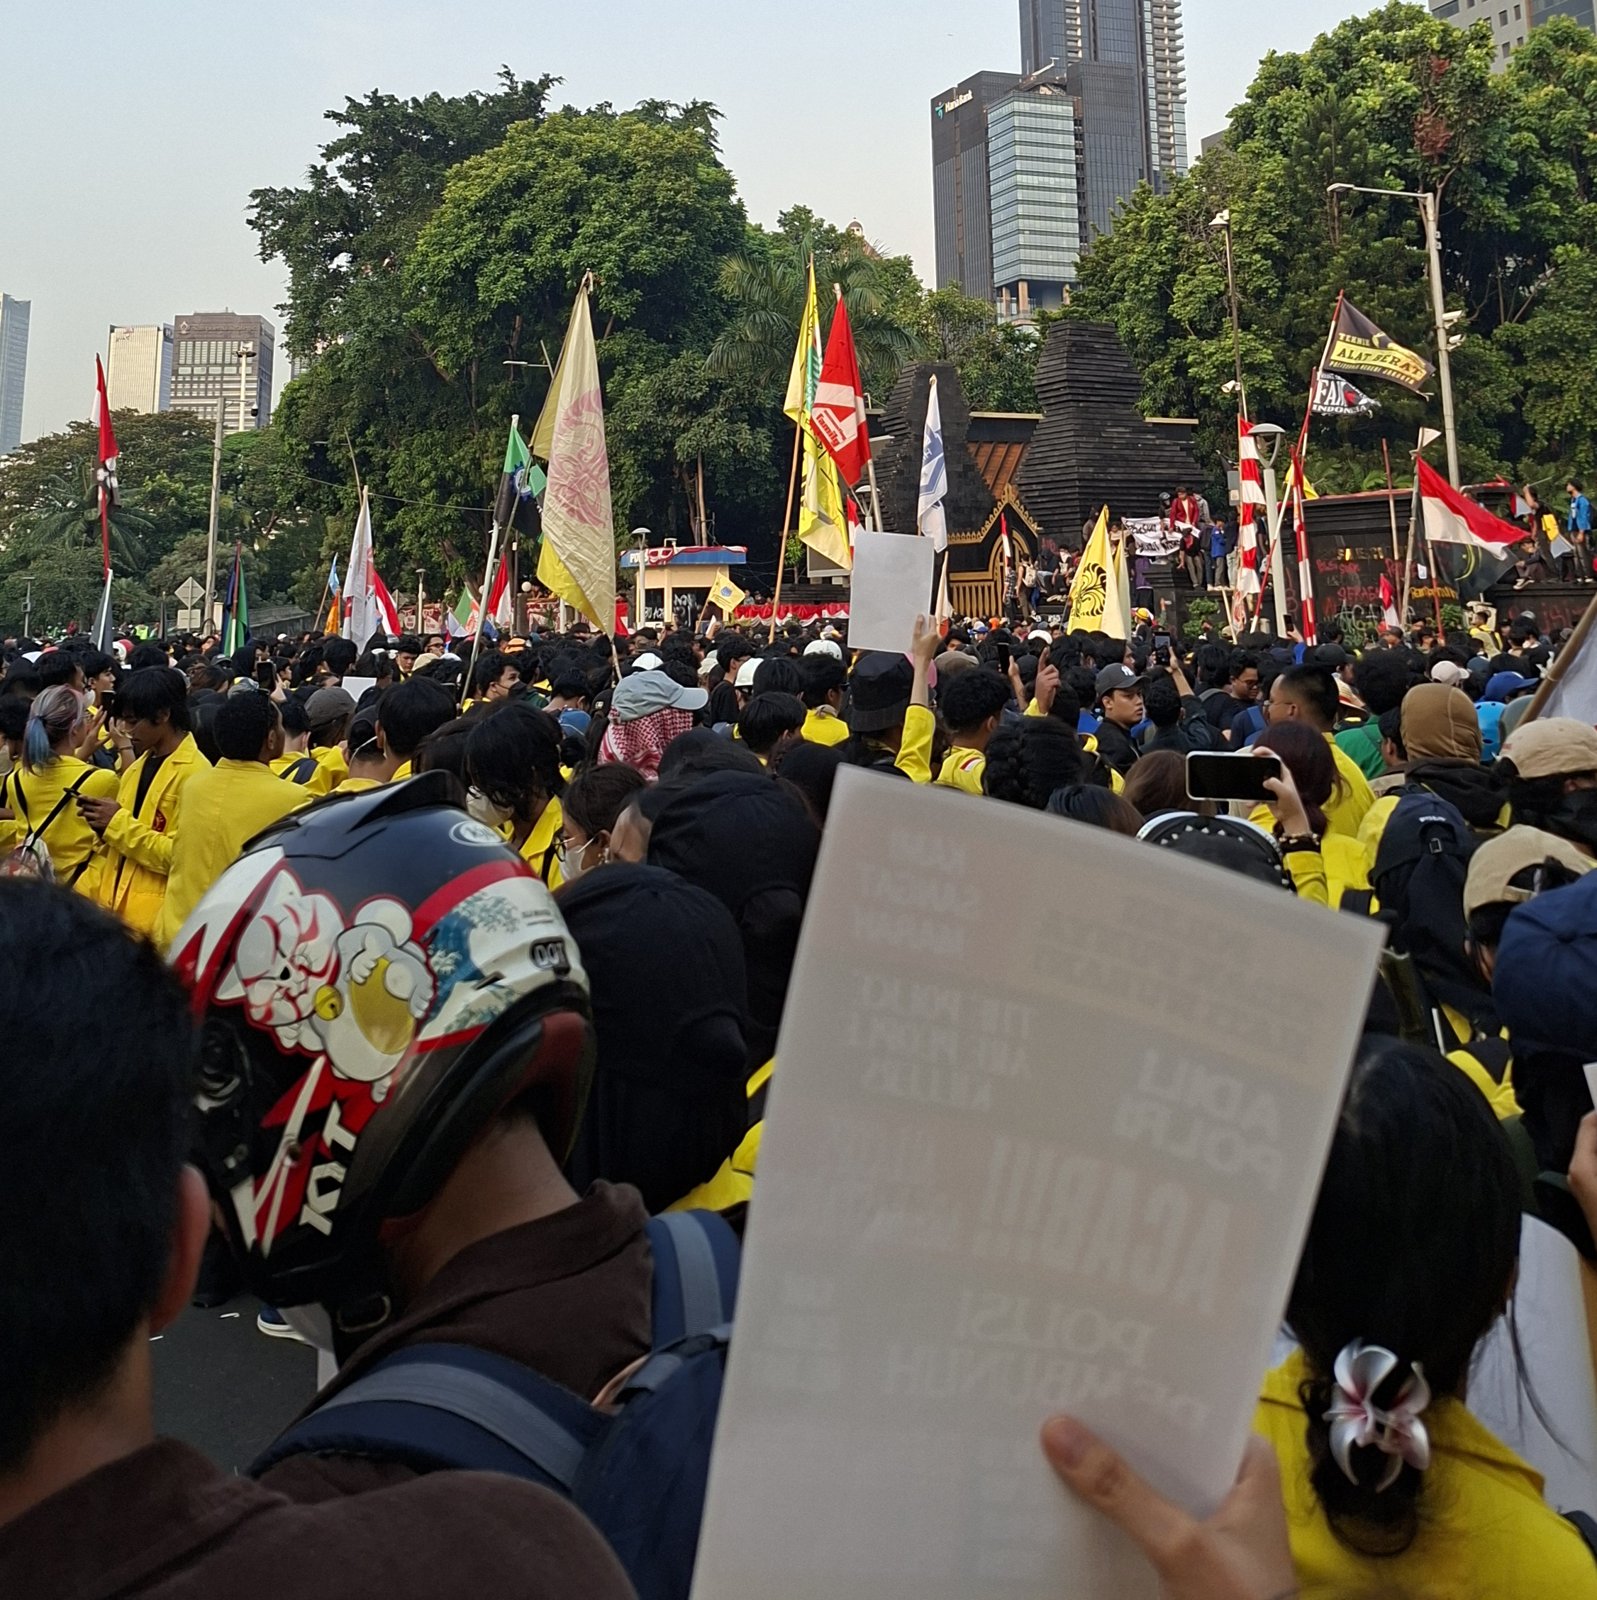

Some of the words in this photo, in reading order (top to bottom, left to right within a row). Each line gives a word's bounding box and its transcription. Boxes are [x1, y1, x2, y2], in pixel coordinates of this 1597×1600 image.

[1337, 347, 1372, 362] ALAT
[1372, 352, 1424, 376] BERAT
[298, 1099, 358, 1236] KYT
